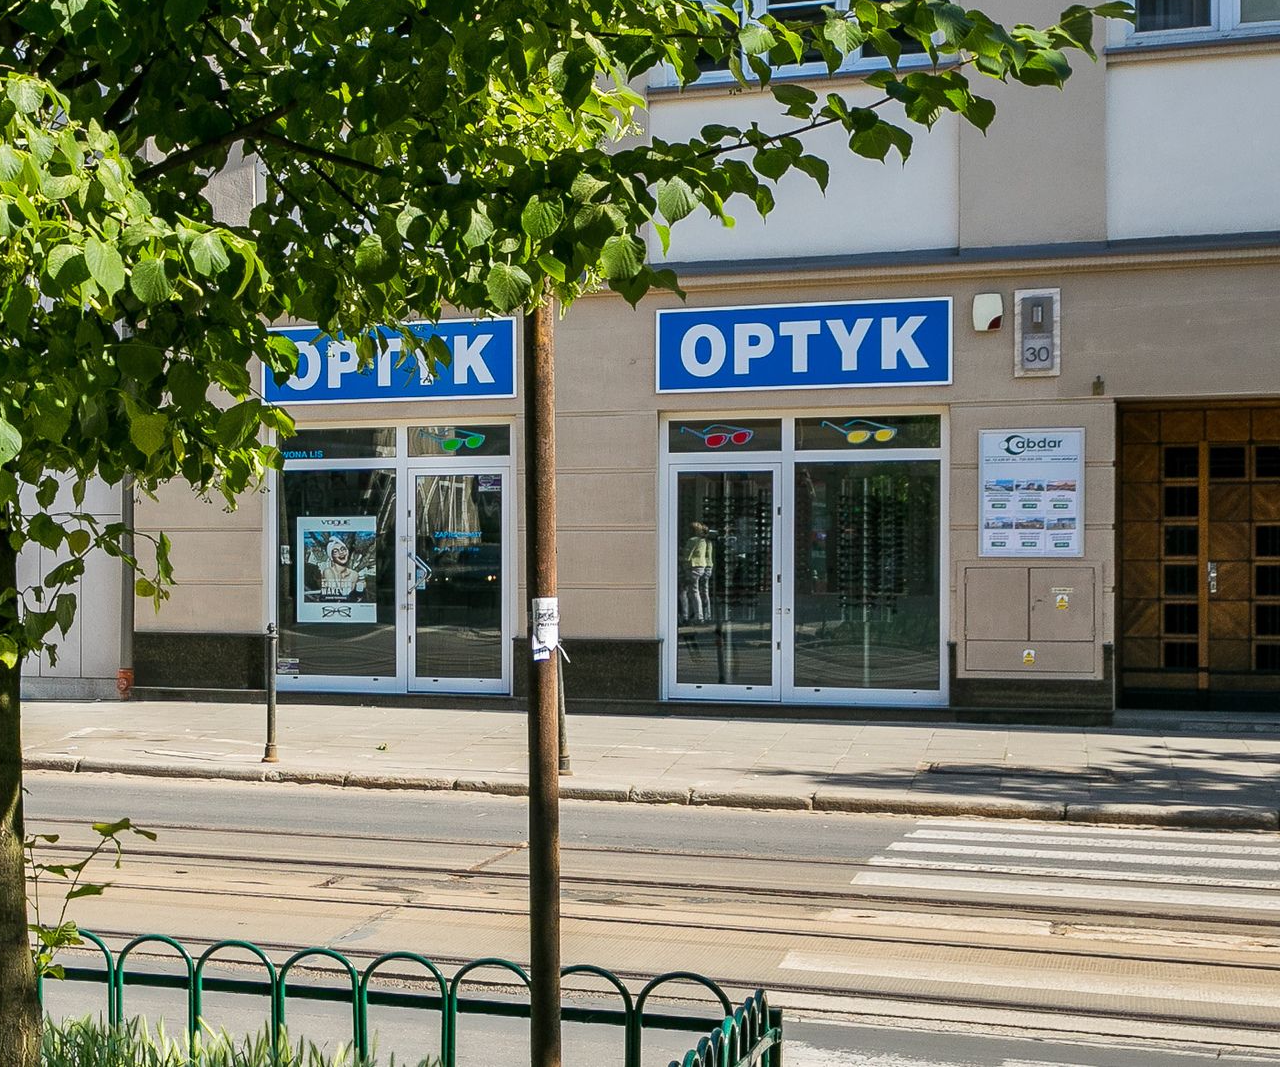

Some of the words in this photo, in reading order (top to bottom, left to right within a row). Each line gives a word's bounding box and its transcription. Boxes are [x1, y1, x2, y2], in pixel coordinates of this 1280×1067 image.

[680, 315, 930, 377] OPTYK
[1025, 346, 1049, 362] 30
[282, 450, 308, 458] WONA
[310, 450, 323, 458] LIS
